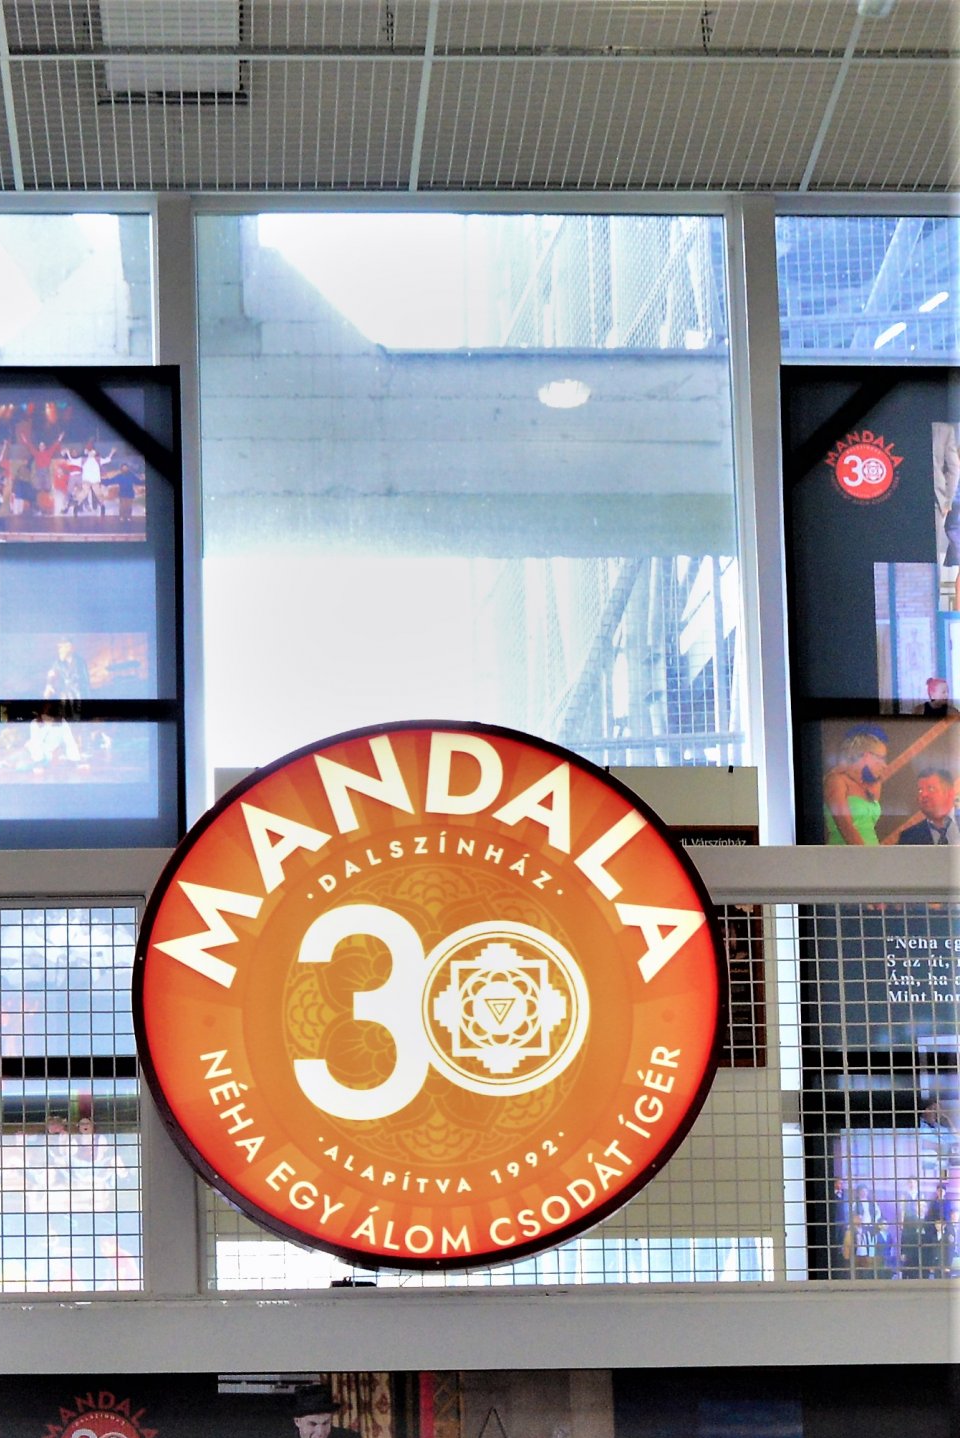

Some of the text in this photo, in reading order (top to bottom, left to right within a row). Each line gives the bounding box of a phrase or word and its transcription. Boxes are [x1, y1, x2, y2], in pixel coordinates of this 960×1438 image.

[825, 429, 904, 467] MANDALA
[153, 731, 706, 989] MANDALA
[318, 835, 553, 893] DALSZÍNHÁZ
[888, 990, 927, 1003] Mint
[199, 1045, 682, 1255] NÉHA EGY ÁLOM CSODÁT ÍGÉR
[323, 1139, 559, 1194] ALAPÍTVA 1992
